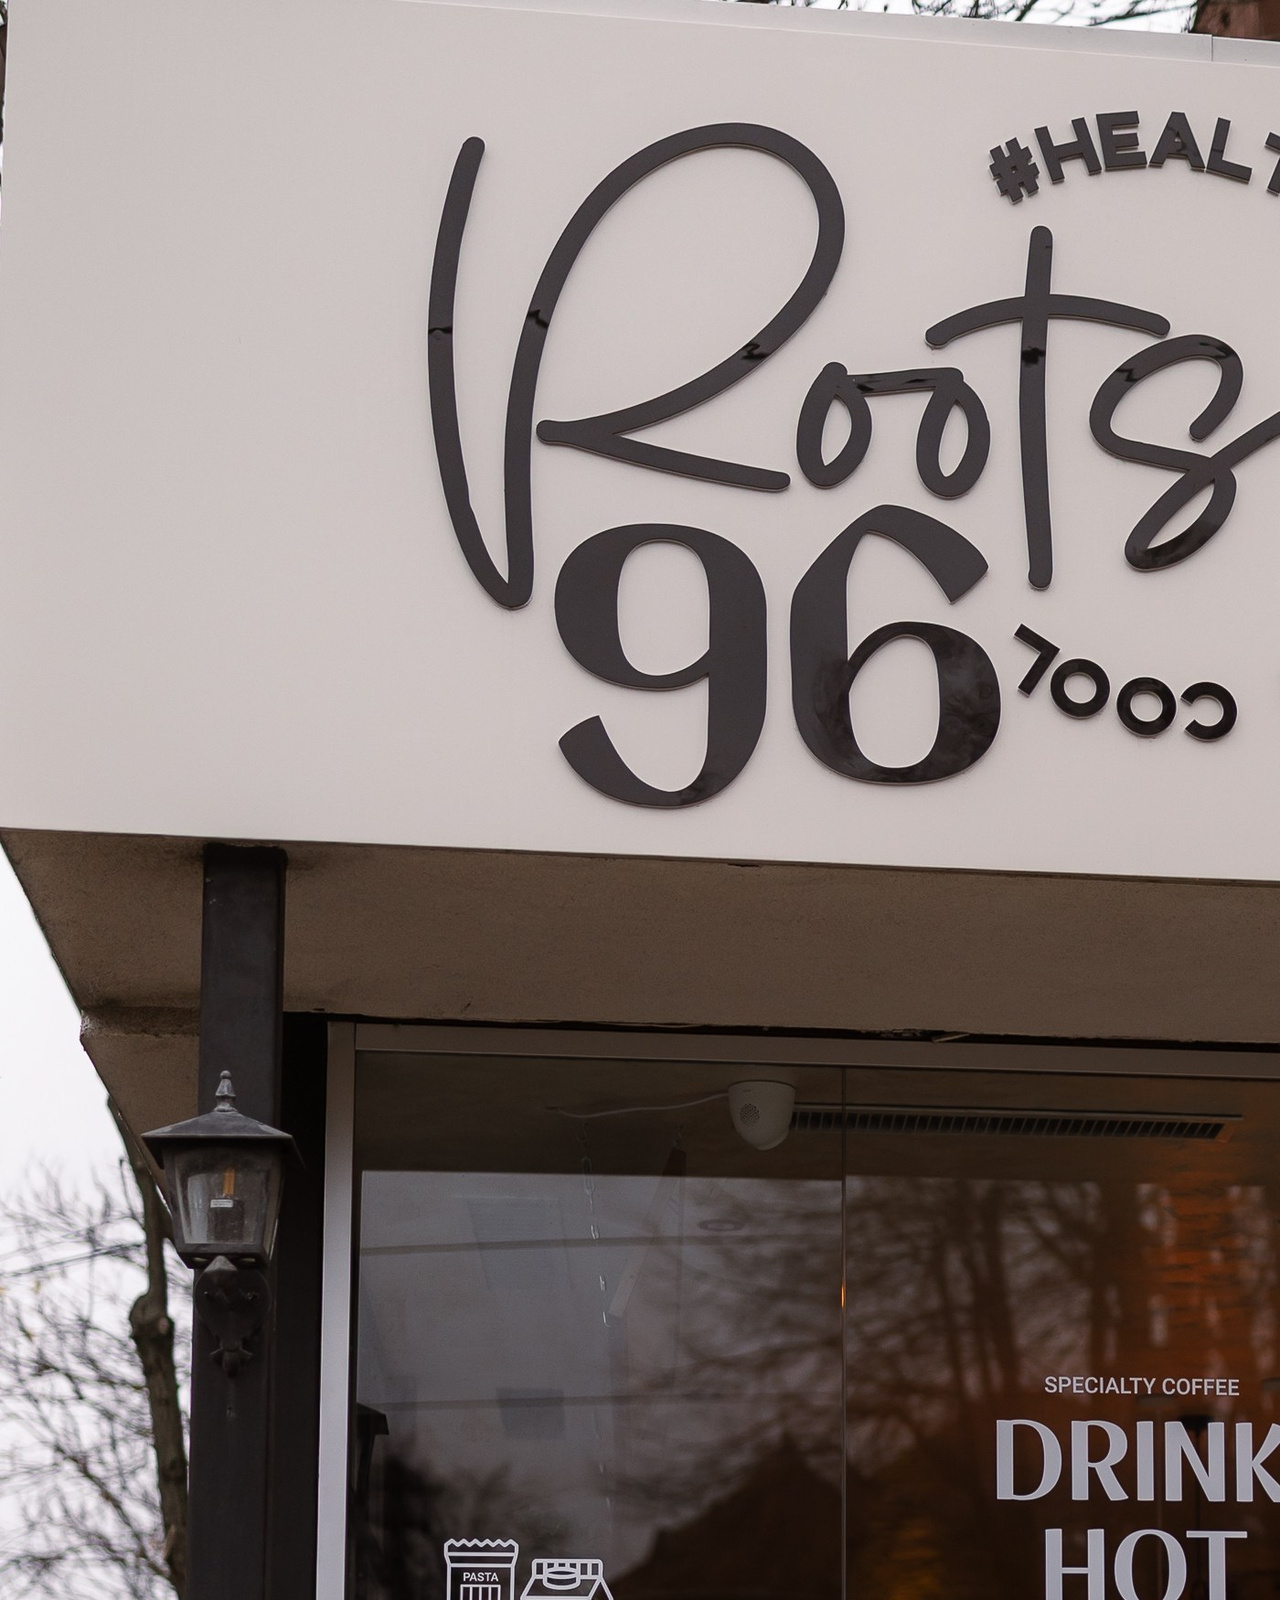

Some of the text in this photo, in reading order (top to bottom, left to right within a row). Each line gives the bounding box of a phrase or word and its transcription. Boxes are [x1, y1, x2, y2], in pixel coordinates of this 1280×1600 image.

[555, 505, 1001, 810] 96
[1014, 624, 1238, 743] COOL
[1044, 1376, 1240, 1396] SPECIALTY COFFEE
[462, 1572, 499, 1582] PASTA
